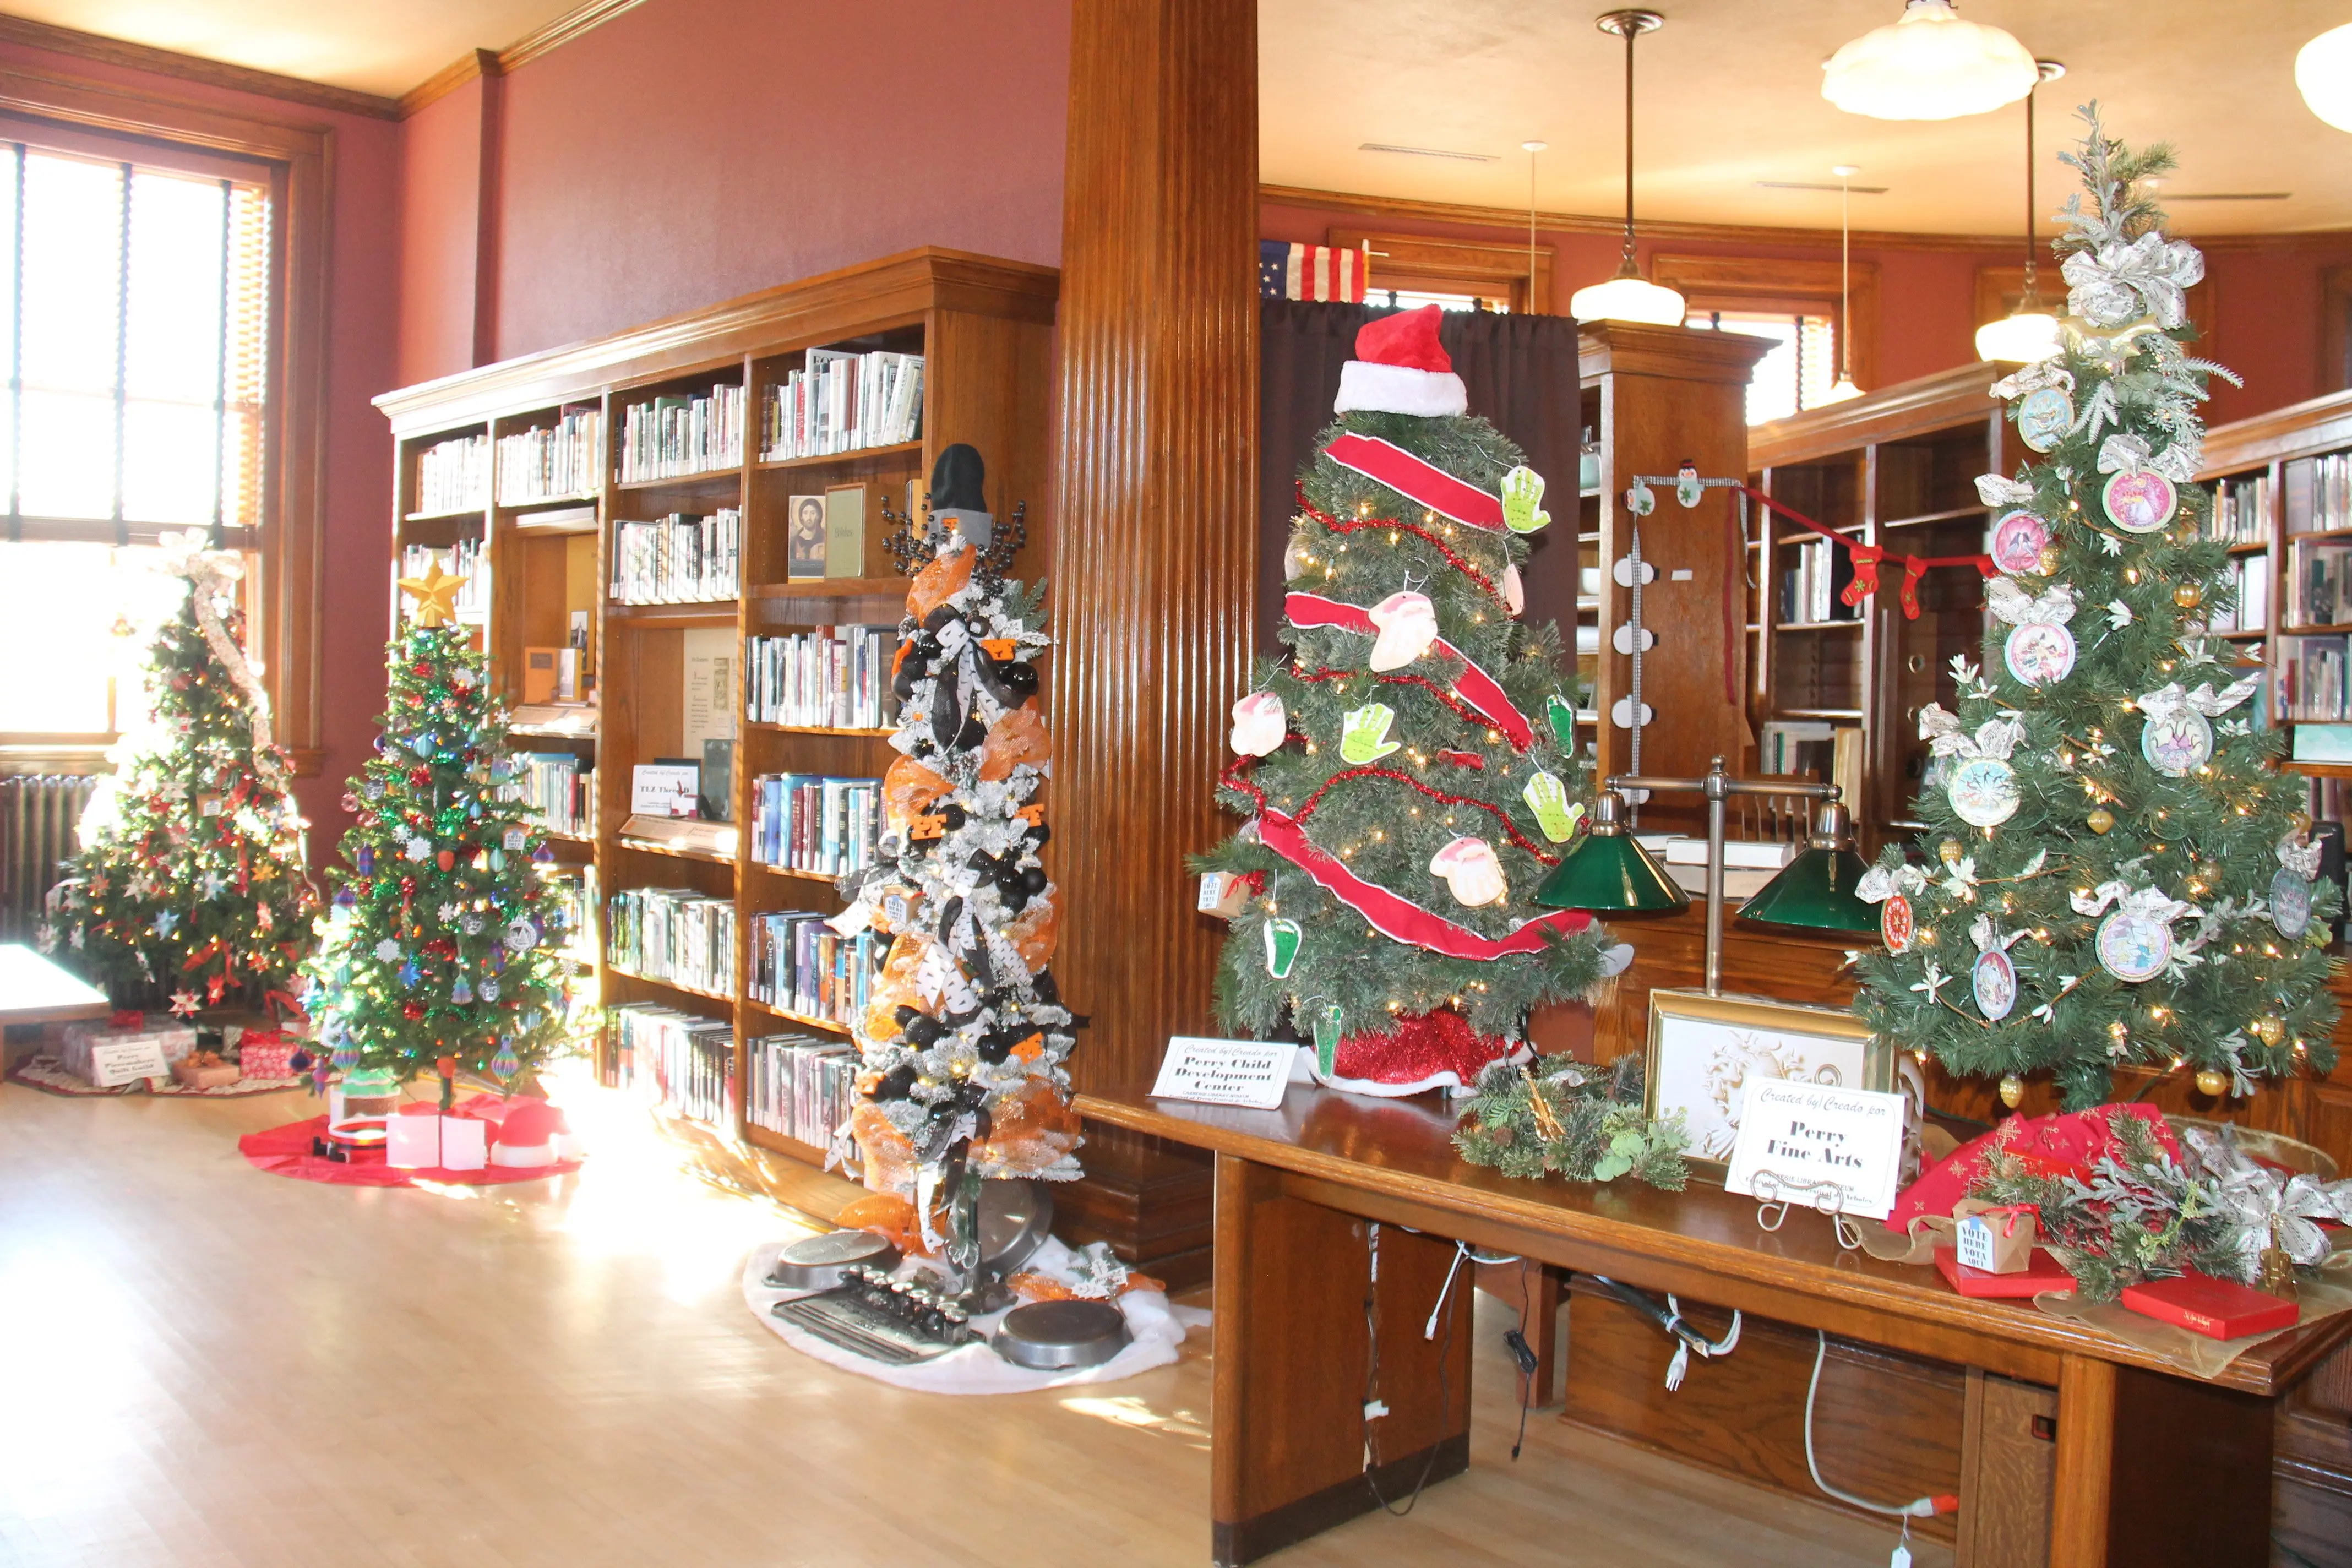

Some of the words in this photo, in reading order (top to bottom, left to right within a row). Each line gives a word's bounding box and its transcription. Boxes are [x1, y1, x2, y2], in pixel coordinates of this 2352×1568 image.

[1184, 1044, 1216, 1054] Created
[1184, 1057, 1226, 1070] Perry
[1231, 1059, 1272, 1069] Child
[1175, 1068, 1272, 1082] Development
[1194, 1080, 1244, 1091] Center
[1761, 1088, 1804, 1105] Created
[1867, 1105, 1886, 1117] por
[1790, 1121, 1848, 1148] Perry
[1767, 1139, 1811, 1160] Fine
[1817, 1148, 1863, 1168] Arts
[1962, 1226, 1988, 1242] VOTE
[1963, 1237, 1986, 1250] HERE
[1964, 1246, 1986, 1261] VOTA
